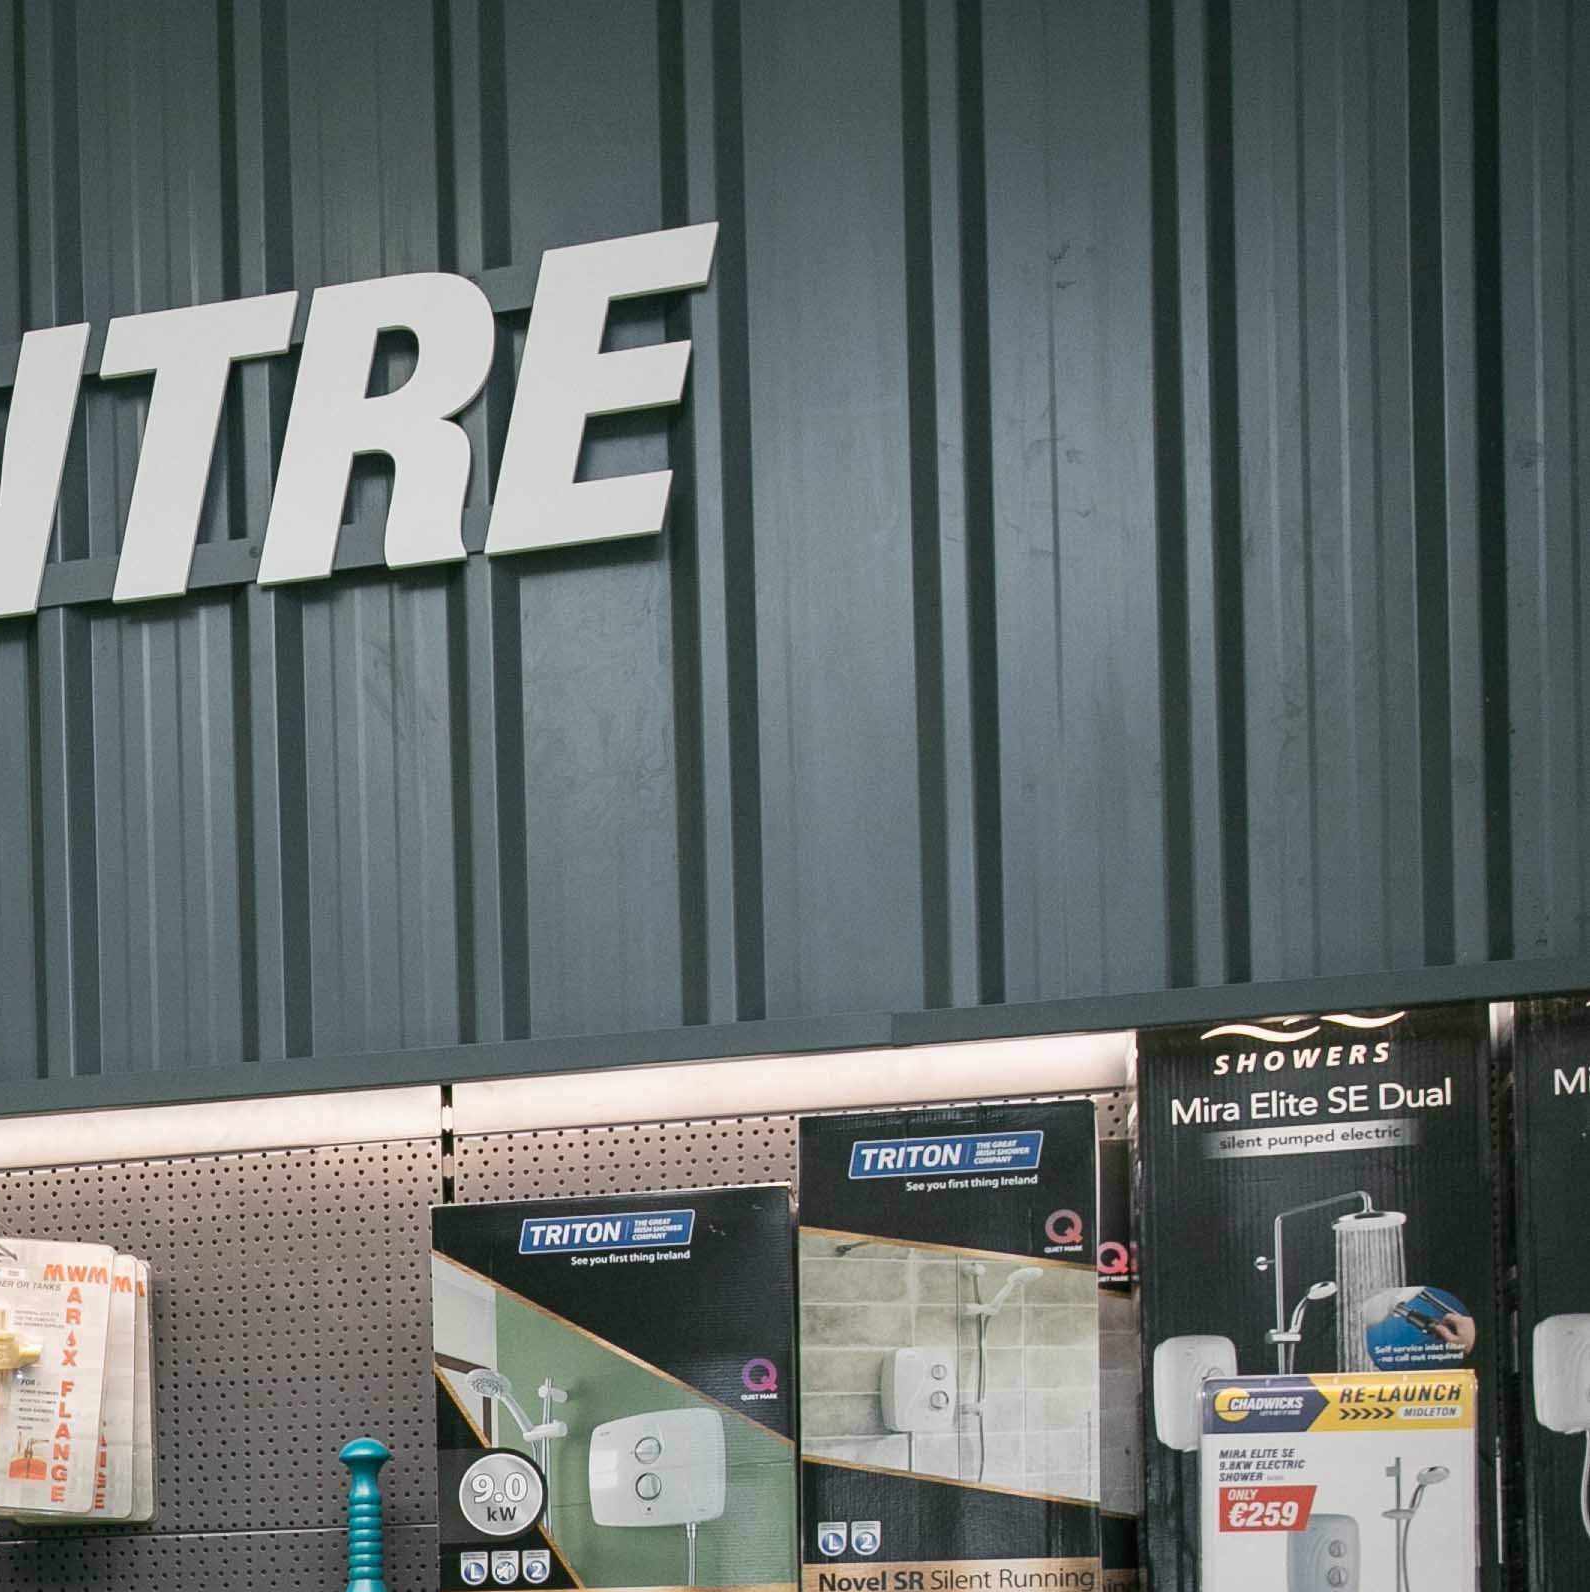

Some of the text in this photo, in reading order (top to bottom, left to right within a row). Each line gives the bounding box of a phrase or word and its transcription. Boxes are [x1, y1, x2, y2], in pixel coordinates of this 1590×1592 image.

[1214, 1042, 1391, 1075] SHOWERS
[1172, 1079, 1452, 1125] Mira Elite SE Dual
[1219, 1125, 1402, 1150] silent pumped electric
[861, 1144, 962, 1171] TRITON
[906, 1174, 1038, 1192] See you first thing Ireland
[530, 1221, 621, 1246] TRITON
[571, 1250, 690, 1267] See you first thing Ireland
[1340, 1384, 1461, 1403] RE-LAUNCH
[1230, 1397, 1303, 1410] CHADWICKS
[1403, 1407, 1457, 1417] MIDLETON
[1219, 1448, 1295, 1458] MIRA ELITE SE
[1219, 1460, 1305, 1470] 9.8KW ELECTRIC
[1219, 1472, 1263, 1482] SHOWER
[470, 1472, 528, 1505] 9.0
[1228, 1489, 1258, 1500] ONLY
[486, 1505, 517, 1524] kW
[1229, 1501, 1299, 1527] €259
[819, 1571, 888, 1592] Novel
[894, 1570, 924, 1591] SR
[930, 1568, 993, 1591] Silent
